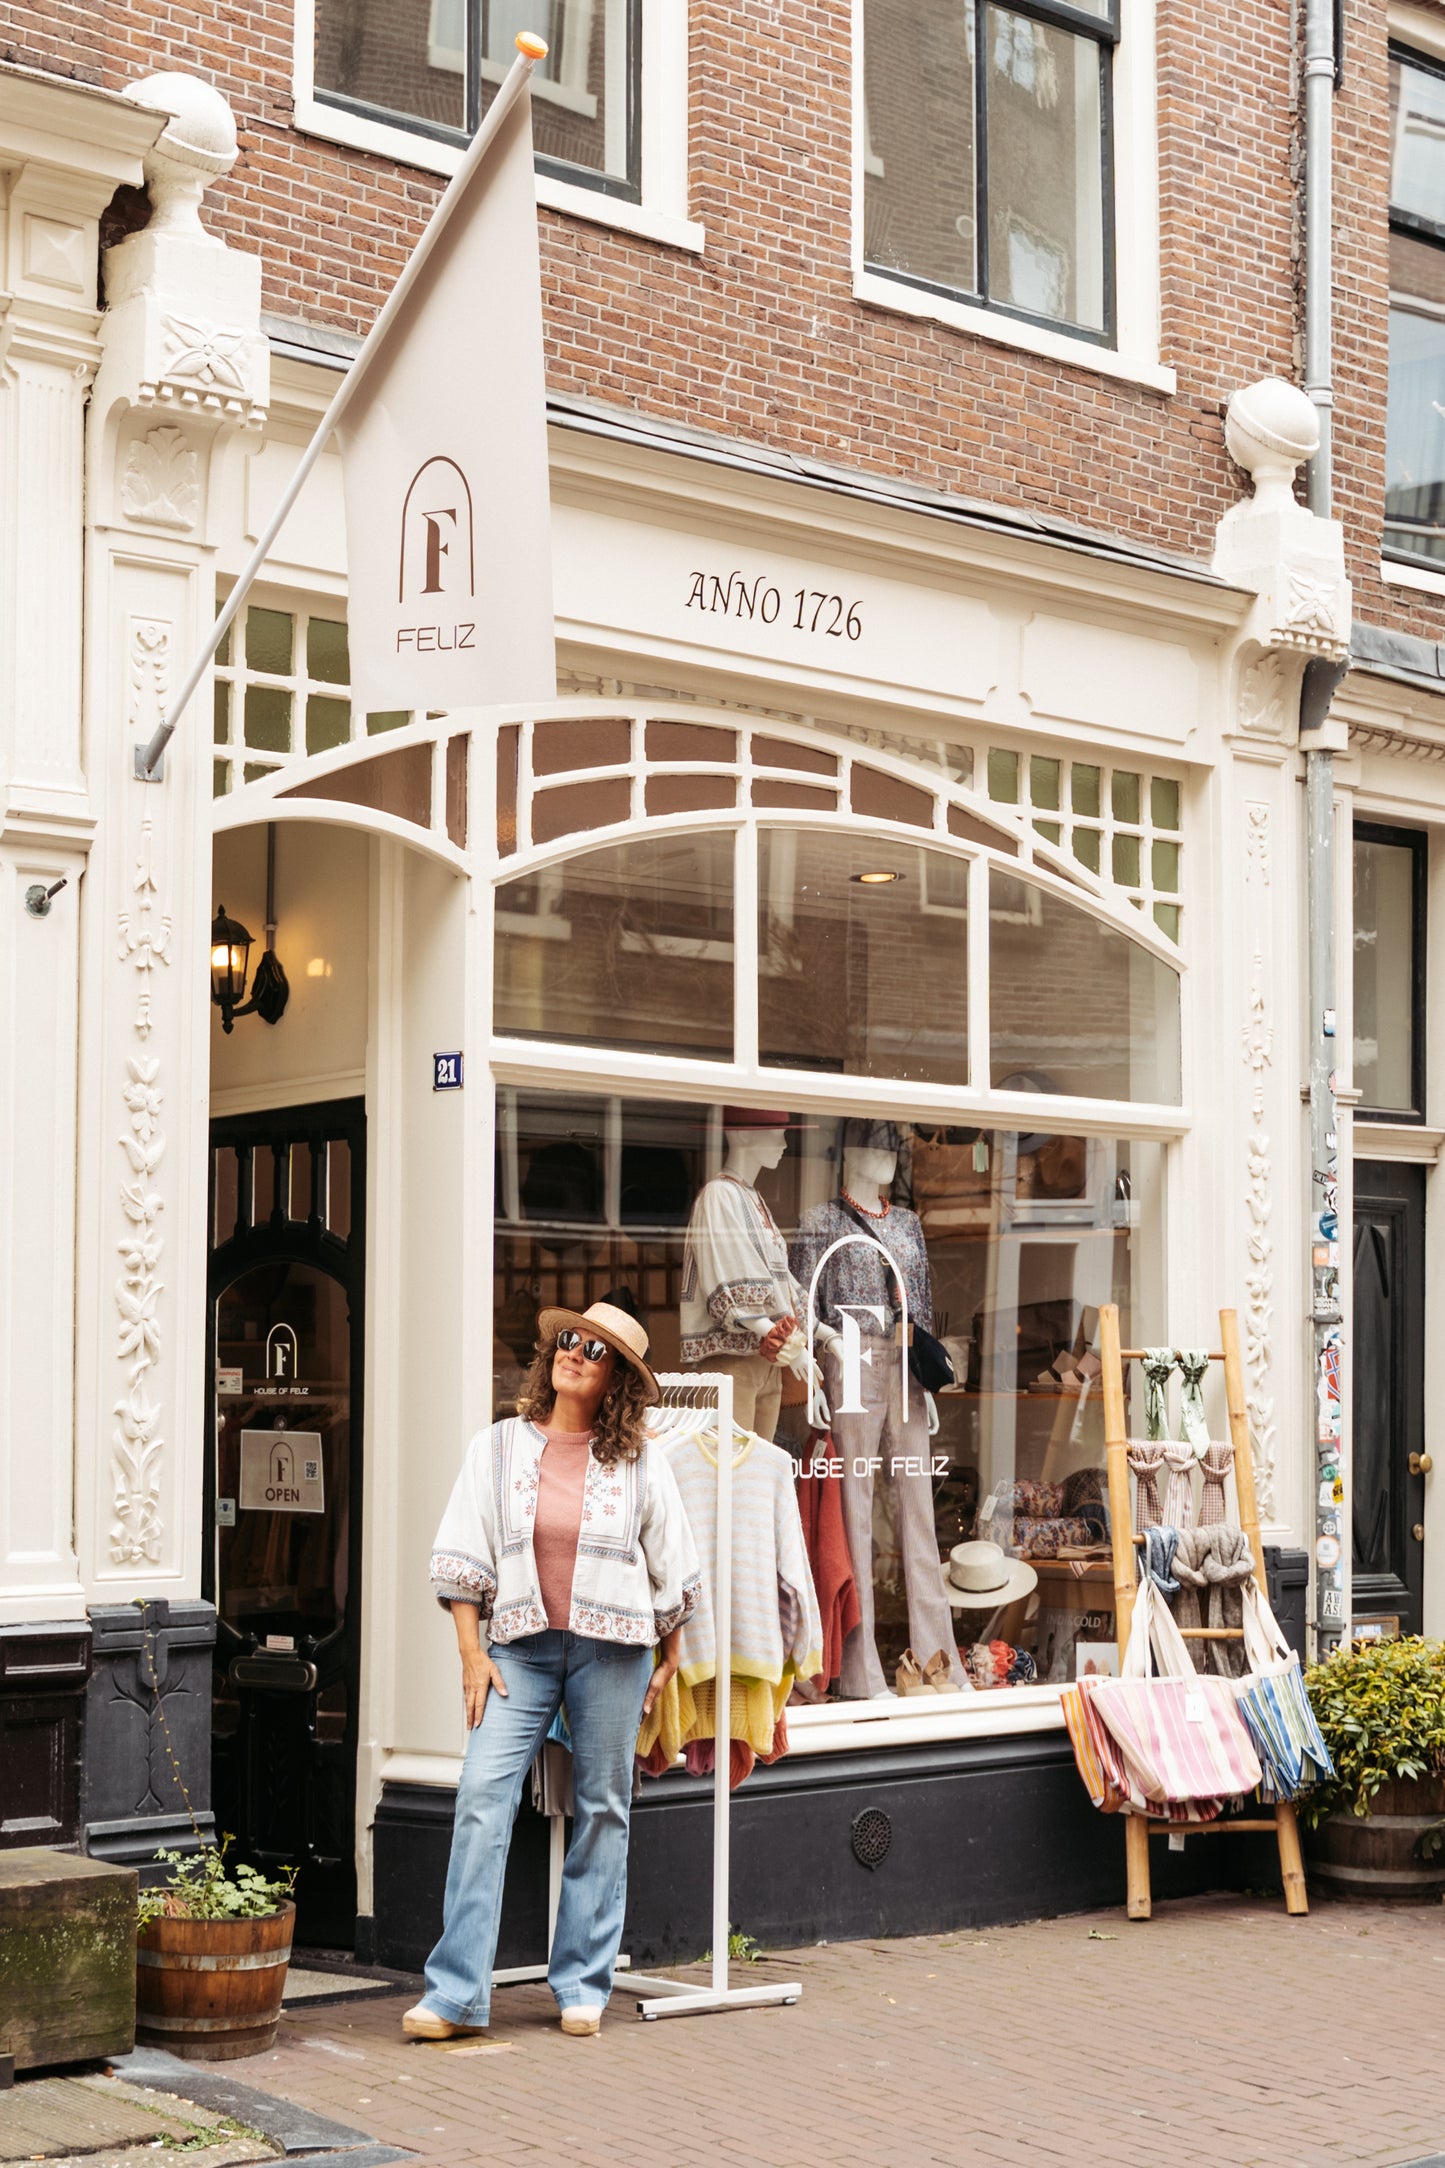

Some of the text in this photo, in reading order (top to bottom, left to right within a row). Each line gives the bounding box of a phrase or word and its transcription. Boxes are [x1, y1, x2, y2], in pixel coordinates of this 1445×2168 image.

[418, 508, 457, 594] F
[684, 570, 865, 641] ANNO 1726
[396, 623, 476, 653] FELIZ
[437, 1058, 457, 1084] 21
[274, 1343, 291, 1376] F
[833, 1304, 886, 1414] F
[253, 1387, 309, 1395] HOUSE OF FELIZ
[276, 1457, 289, 1482] F
[791, 1455, 950, 1479] OUSE OF FELIZ
[265, 1487, 300, 1502] OPEN
